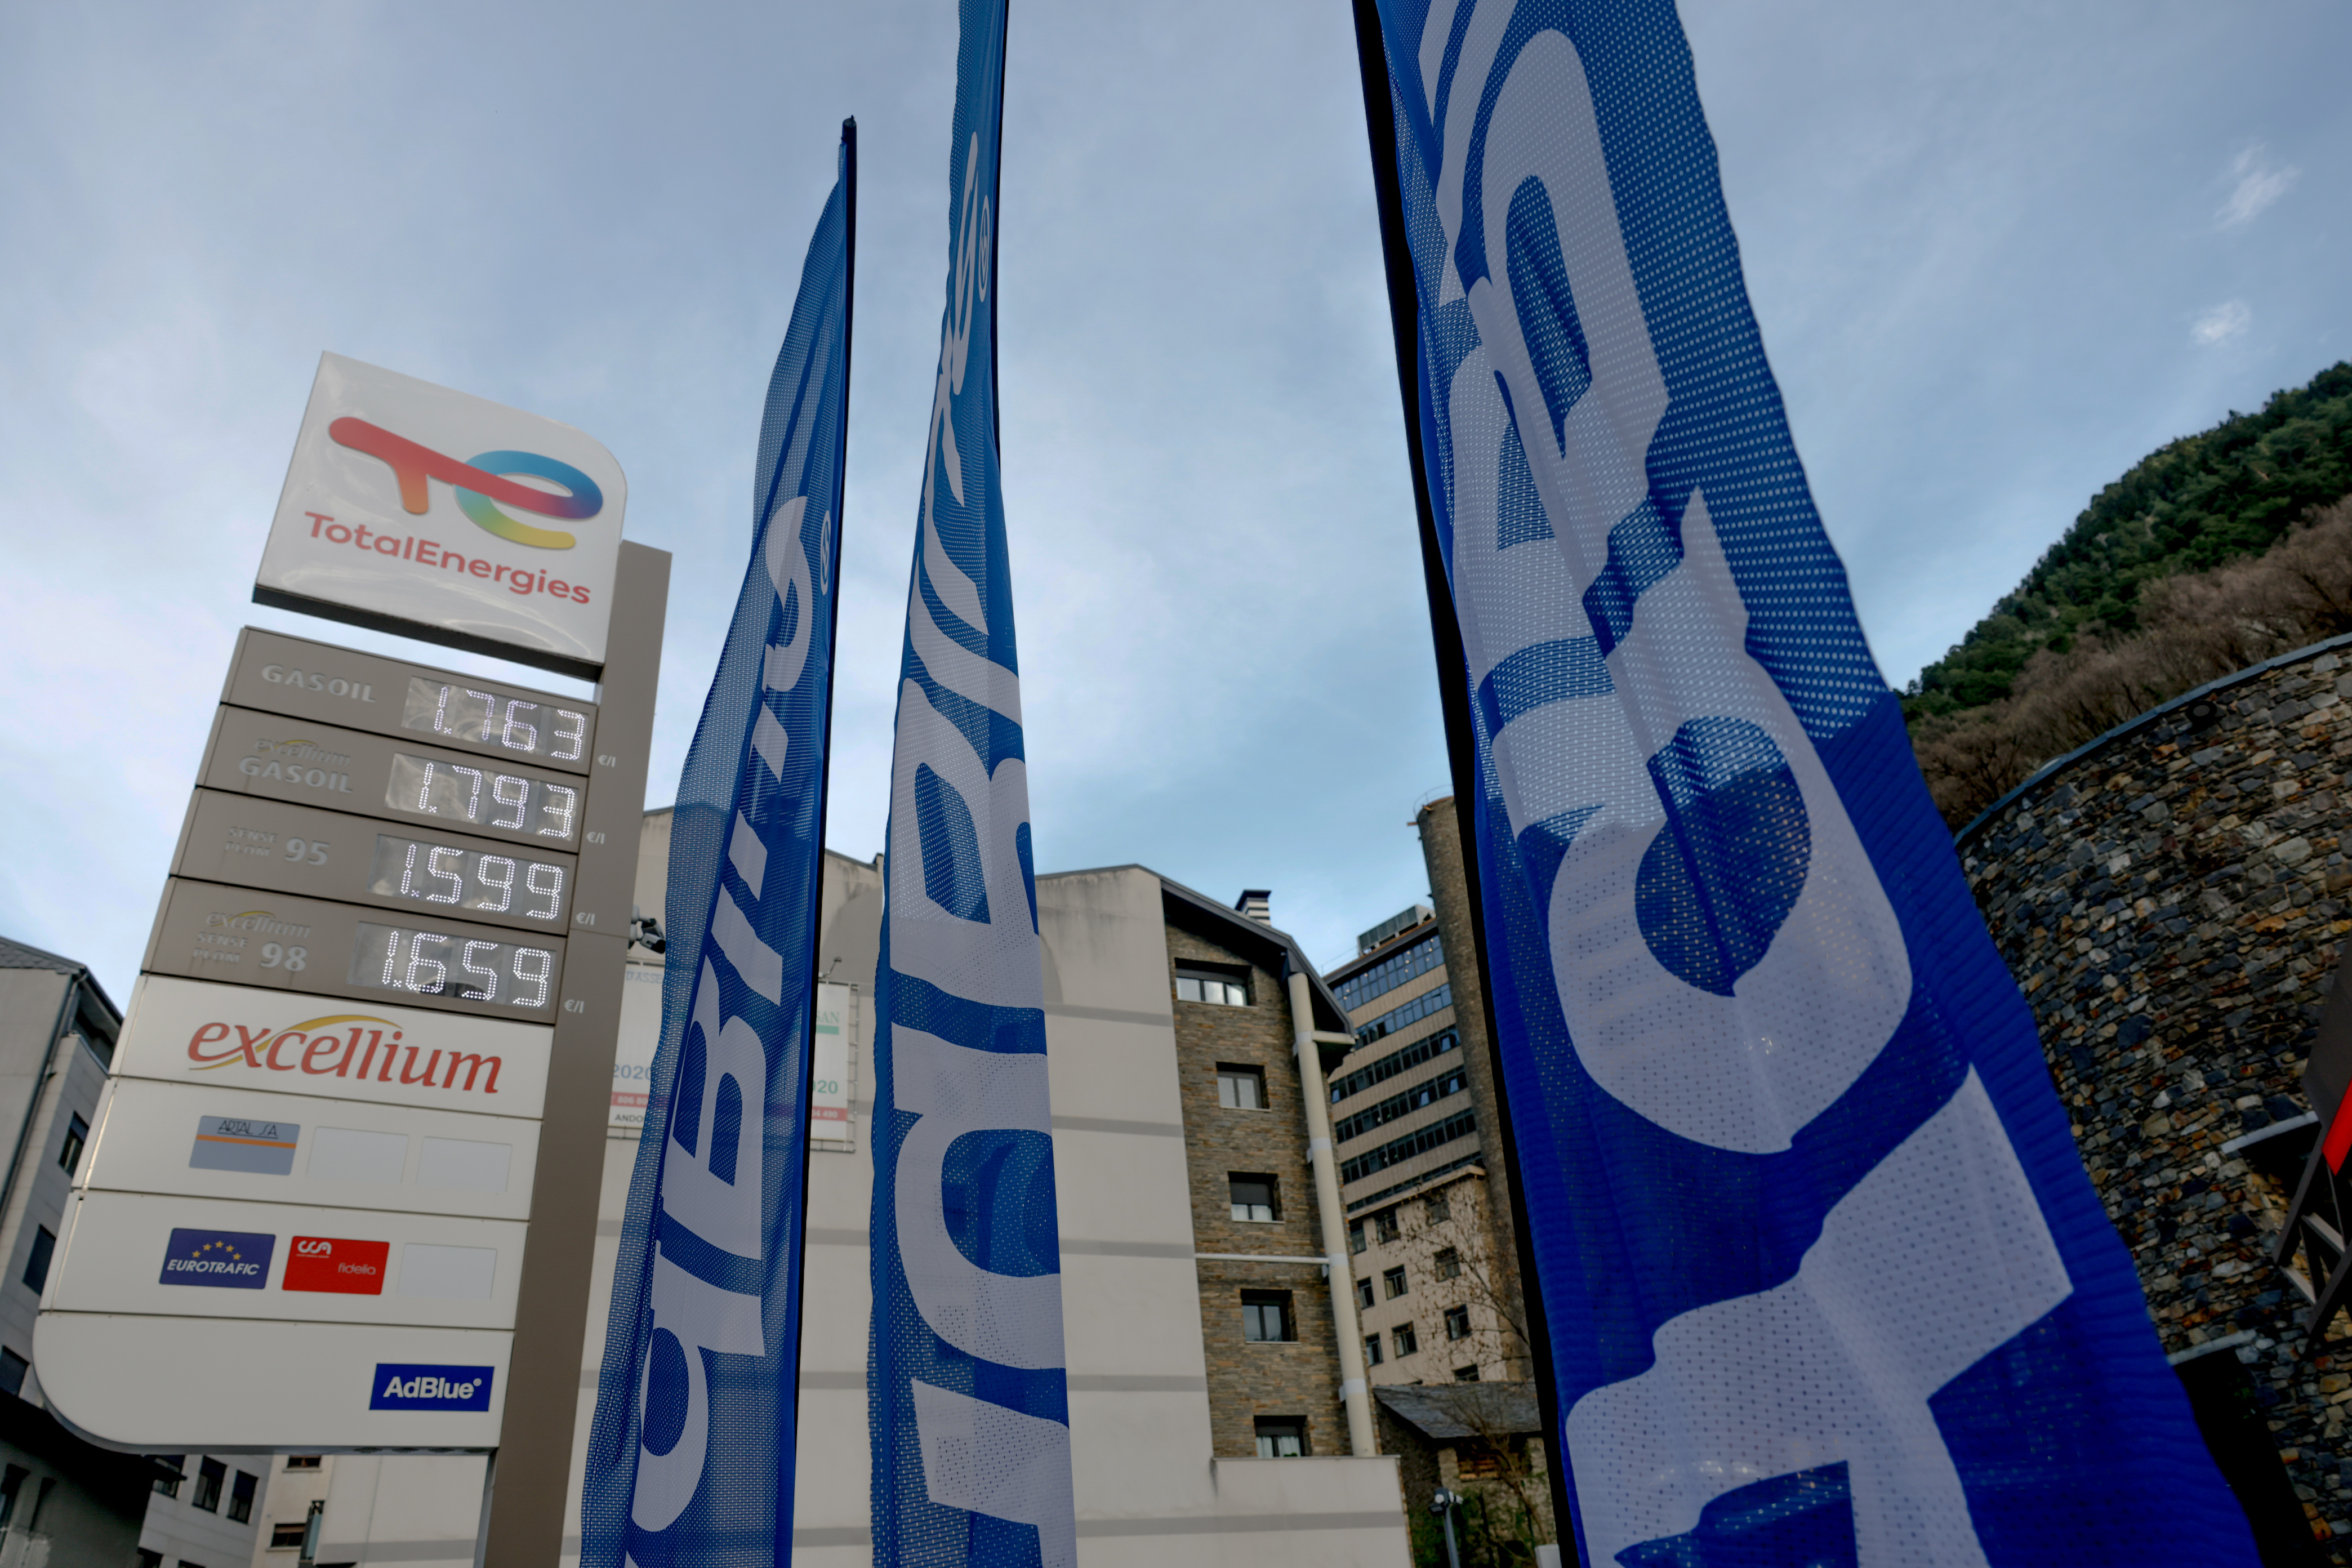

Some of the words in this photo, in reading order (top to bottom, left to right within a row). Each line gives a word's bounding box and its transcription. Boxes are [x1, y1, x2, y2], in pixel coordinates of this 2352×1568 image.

[305, 510, 591, 605] TotalEnergies
[261, 663, 376, 703] GASOIL
[434, 685, 585, 761] 1.763
[254, 738, 351, 767] excellium
[239, 755, 353, 794] GASOIL
[418, 762, 576, 839] 1.793
[225, 841, 270, 857] PLOM
[229, 826, 278, 843] SENSE
[284, 836, 330, 866] 95
[400, 843, 563, 920] 1.599
[197, 932, 249, 948] SENSE
[206, 911, 311, 939] excellium
[193, 947, 241, 964] PLOM
[260, 941, 308, 972] 98
[381, 930, 551, 1008] 1.659
[188, 1019, 502, 1094] excellium
[615, 1113, 645, 1123] ANDO
[167, 1259, 260, 1276] EUROTRAFIC
